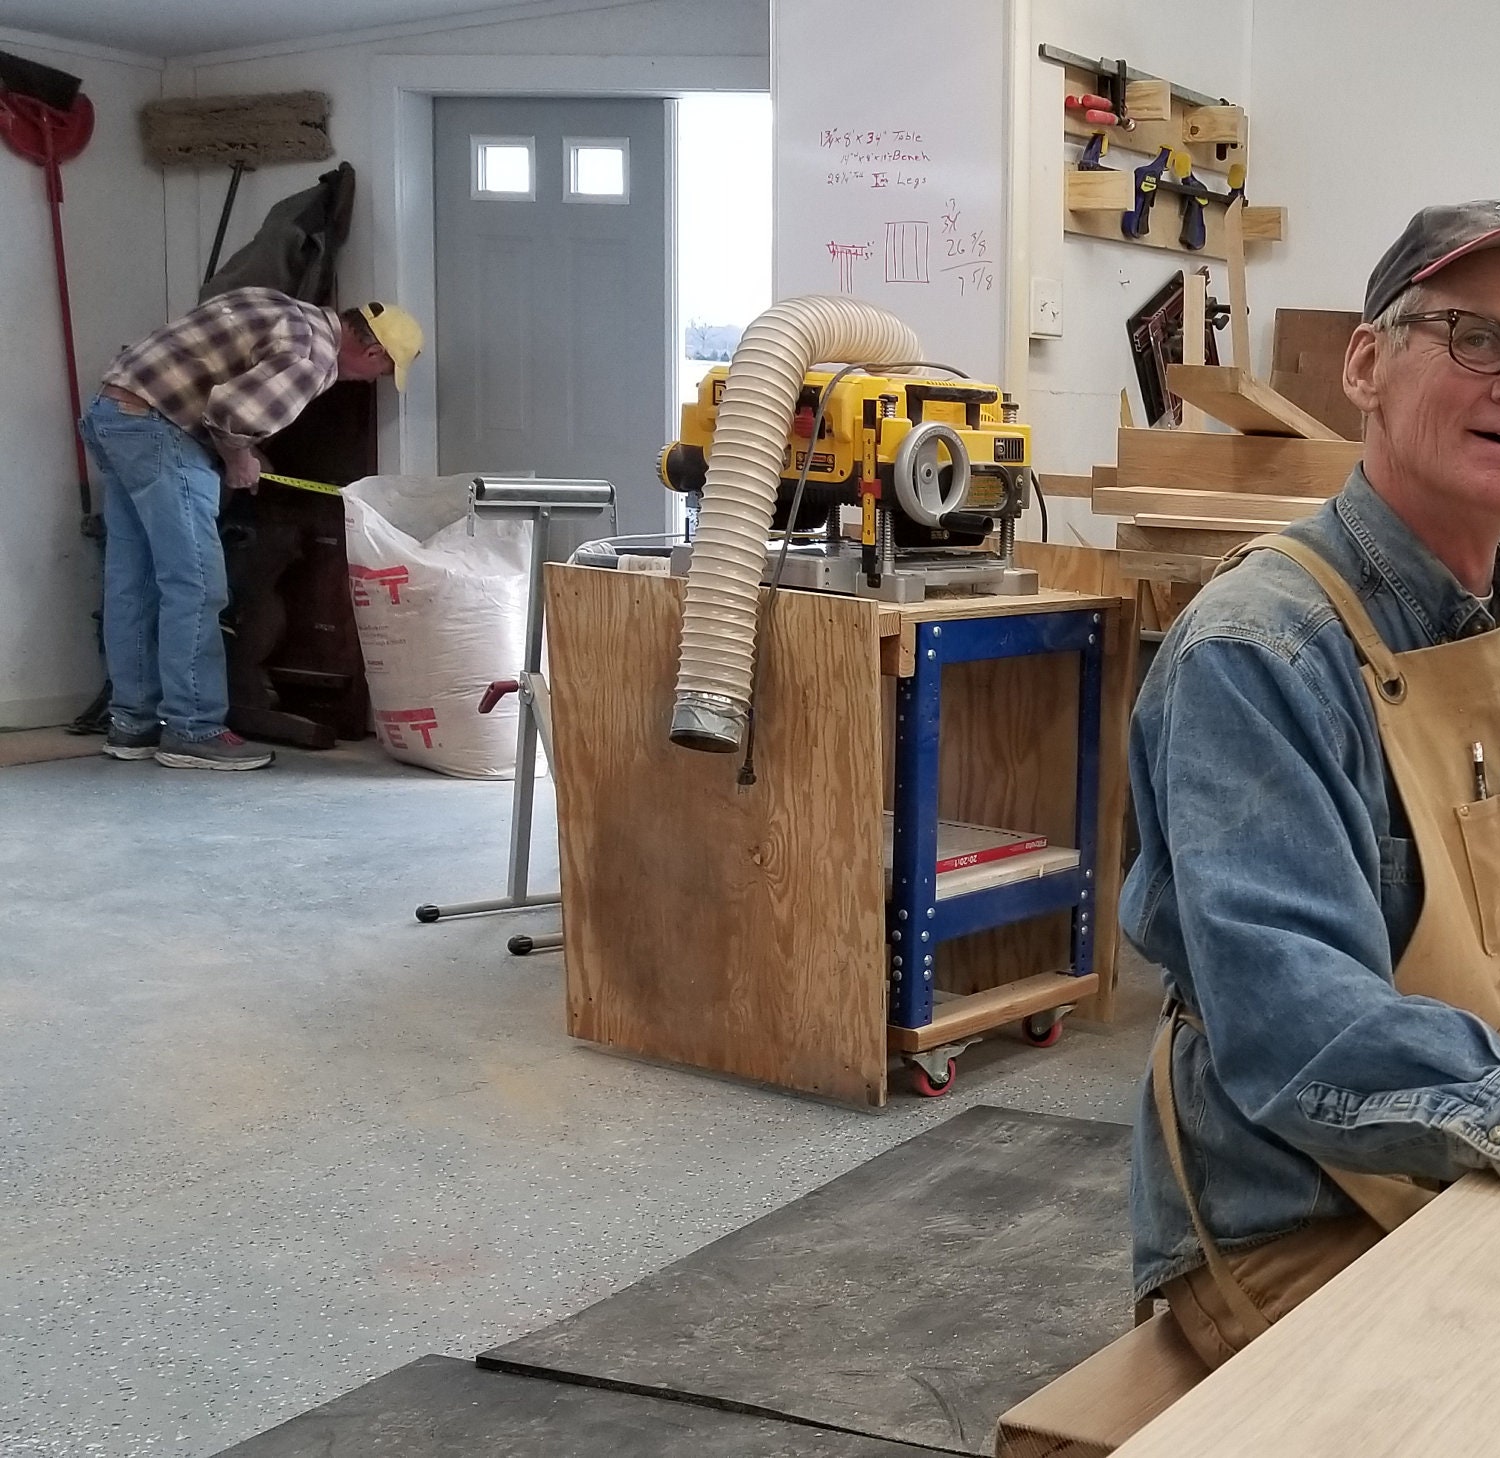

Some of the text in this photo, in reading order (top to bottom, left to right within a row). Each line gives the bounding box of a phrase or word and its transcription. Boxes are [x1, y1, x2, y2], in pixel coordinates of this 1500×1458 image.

[892, 130, 923, 142] Table
[892, 150, 931, 161] Bench
[897, 171, 927, 189] Legs
[946, 239, 965, 256] 26
[972, 266, 993, 290] 5/8
[351, 577, 409, 607] ET
